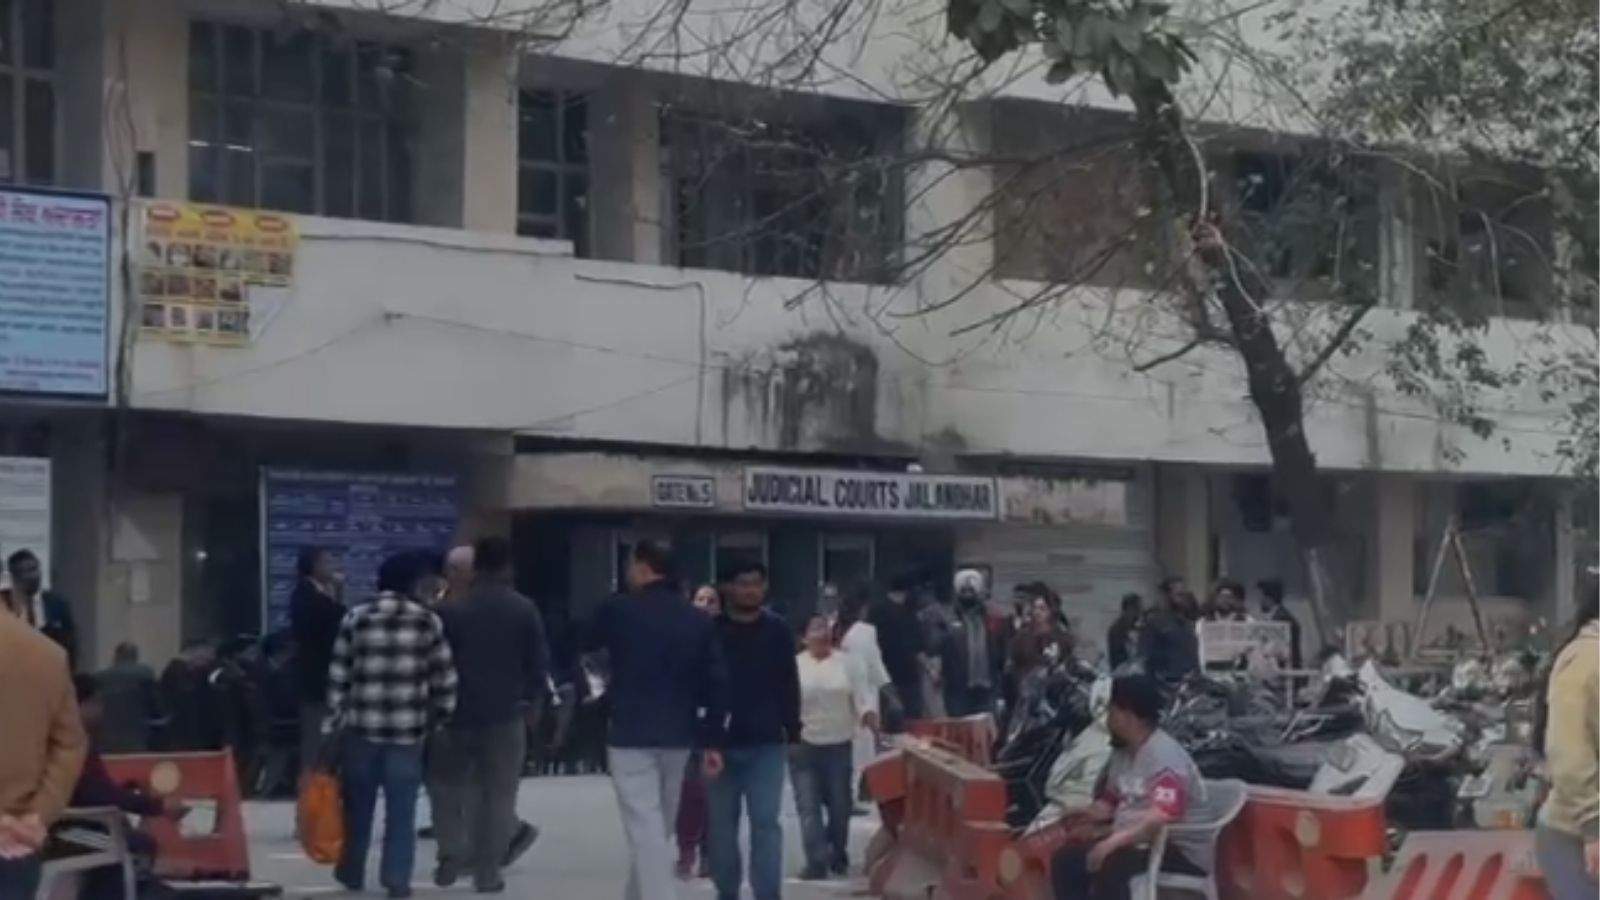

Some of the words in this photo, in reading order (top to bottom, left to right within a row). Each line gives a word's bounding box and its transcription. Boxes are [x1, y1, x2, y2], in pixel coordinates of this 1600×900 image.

[748, 472, 829, 506] JUDICIAL
[834, 477, 899, 510] COURTS
[903, 480, 991, 513] JALANDHAR
